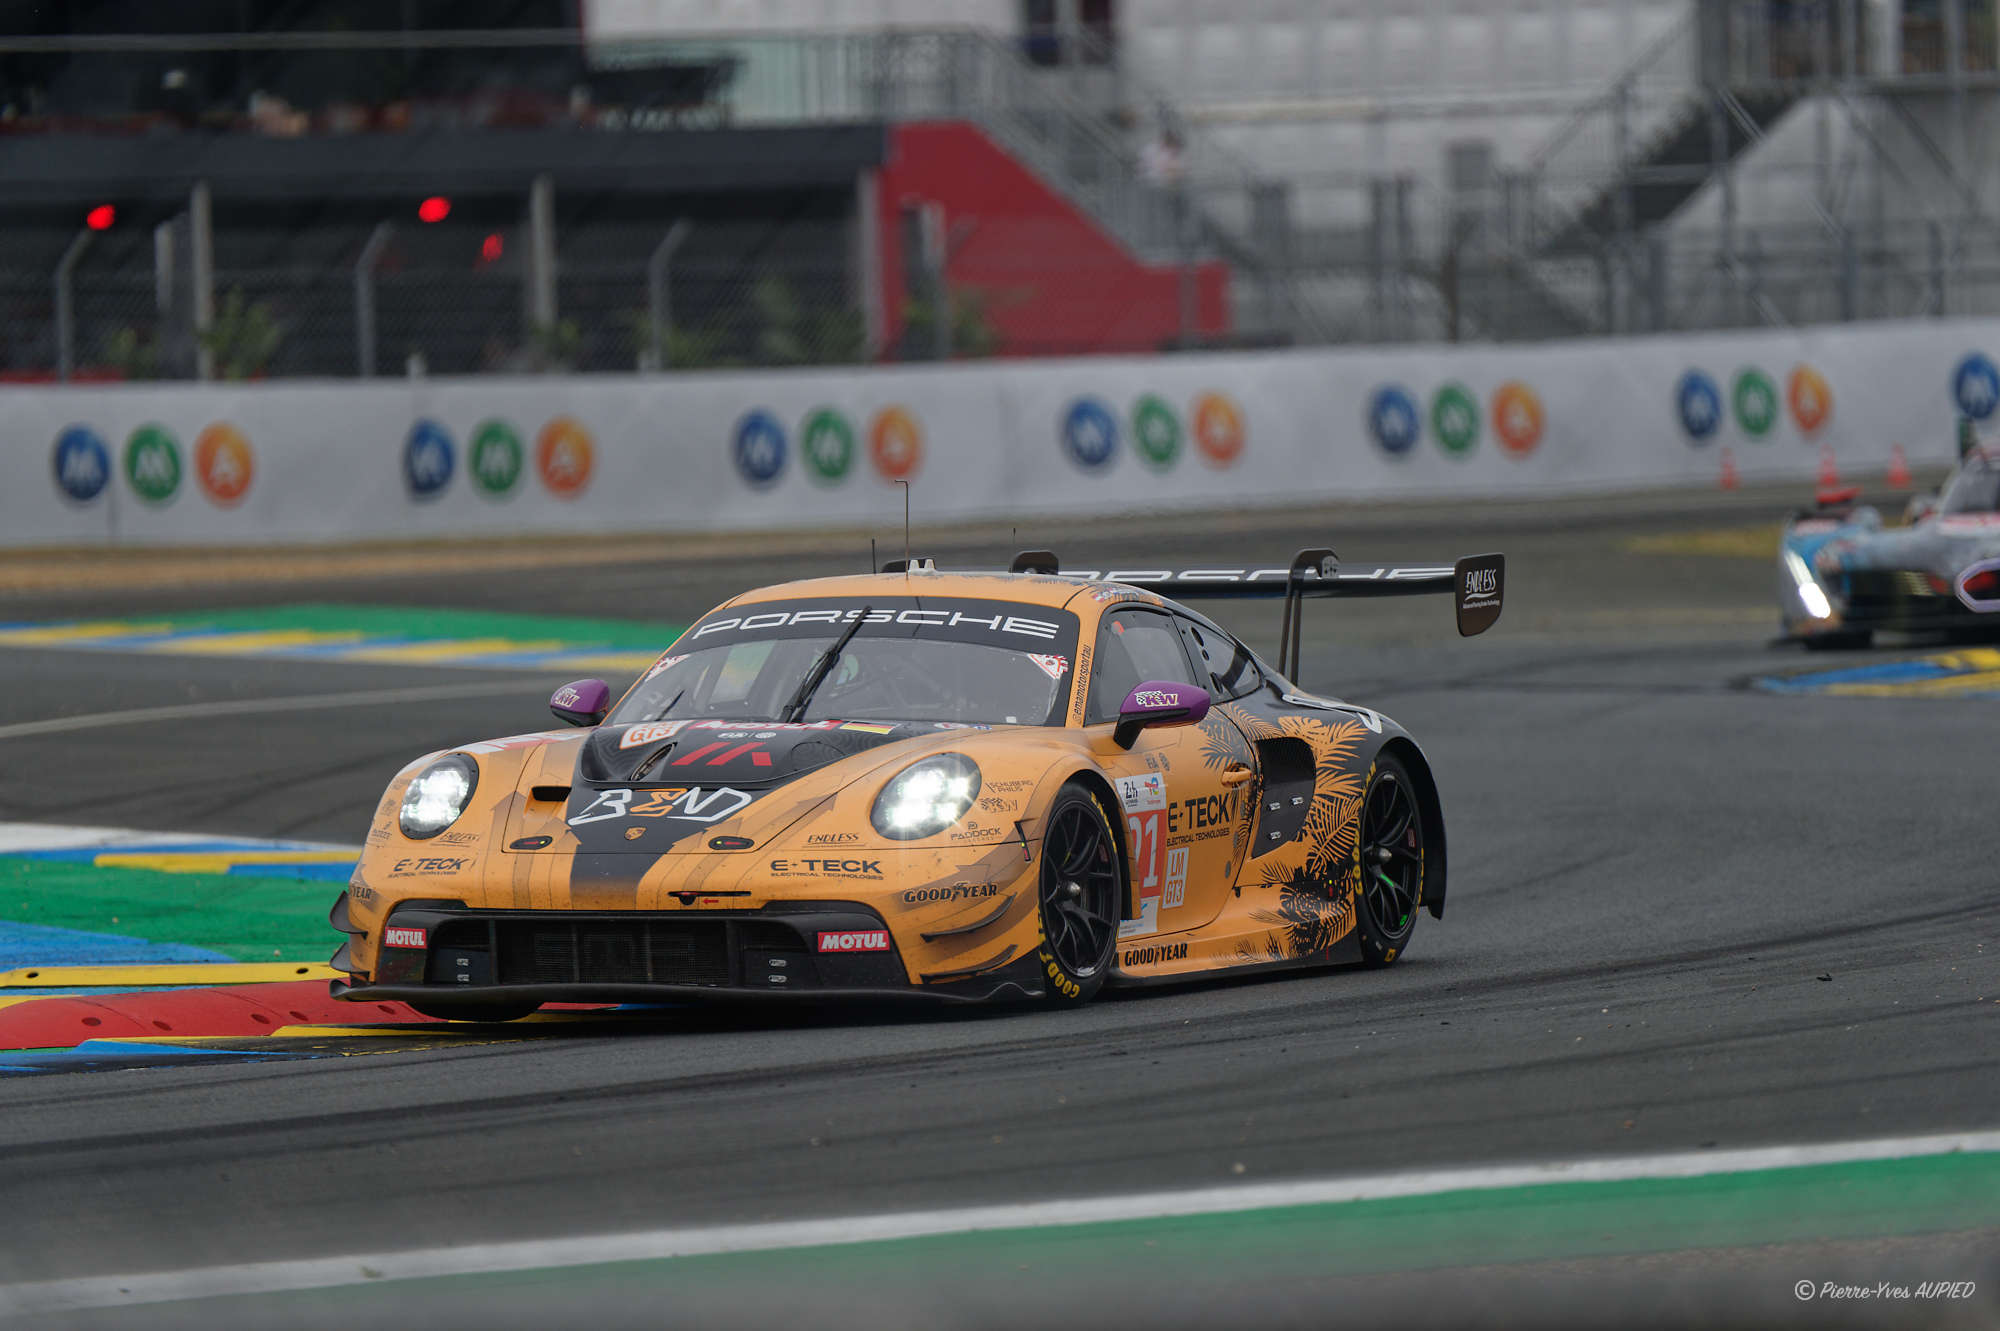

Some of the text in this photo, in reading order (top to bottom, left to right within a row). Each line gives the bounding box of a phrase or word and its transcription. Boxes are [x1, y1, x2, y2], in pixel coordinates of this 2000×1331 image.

[692, 609, 1059, 639] PORSCHE
[807, 833, 859, 844] ENDLESS
[903, 883, 998, 902] GOODYEAR
[386, 930, 425, 946] MOTUL
[821, 933, 887, 950] MOTUL
[1124, 943, 1188, 967] GOODYEAR
